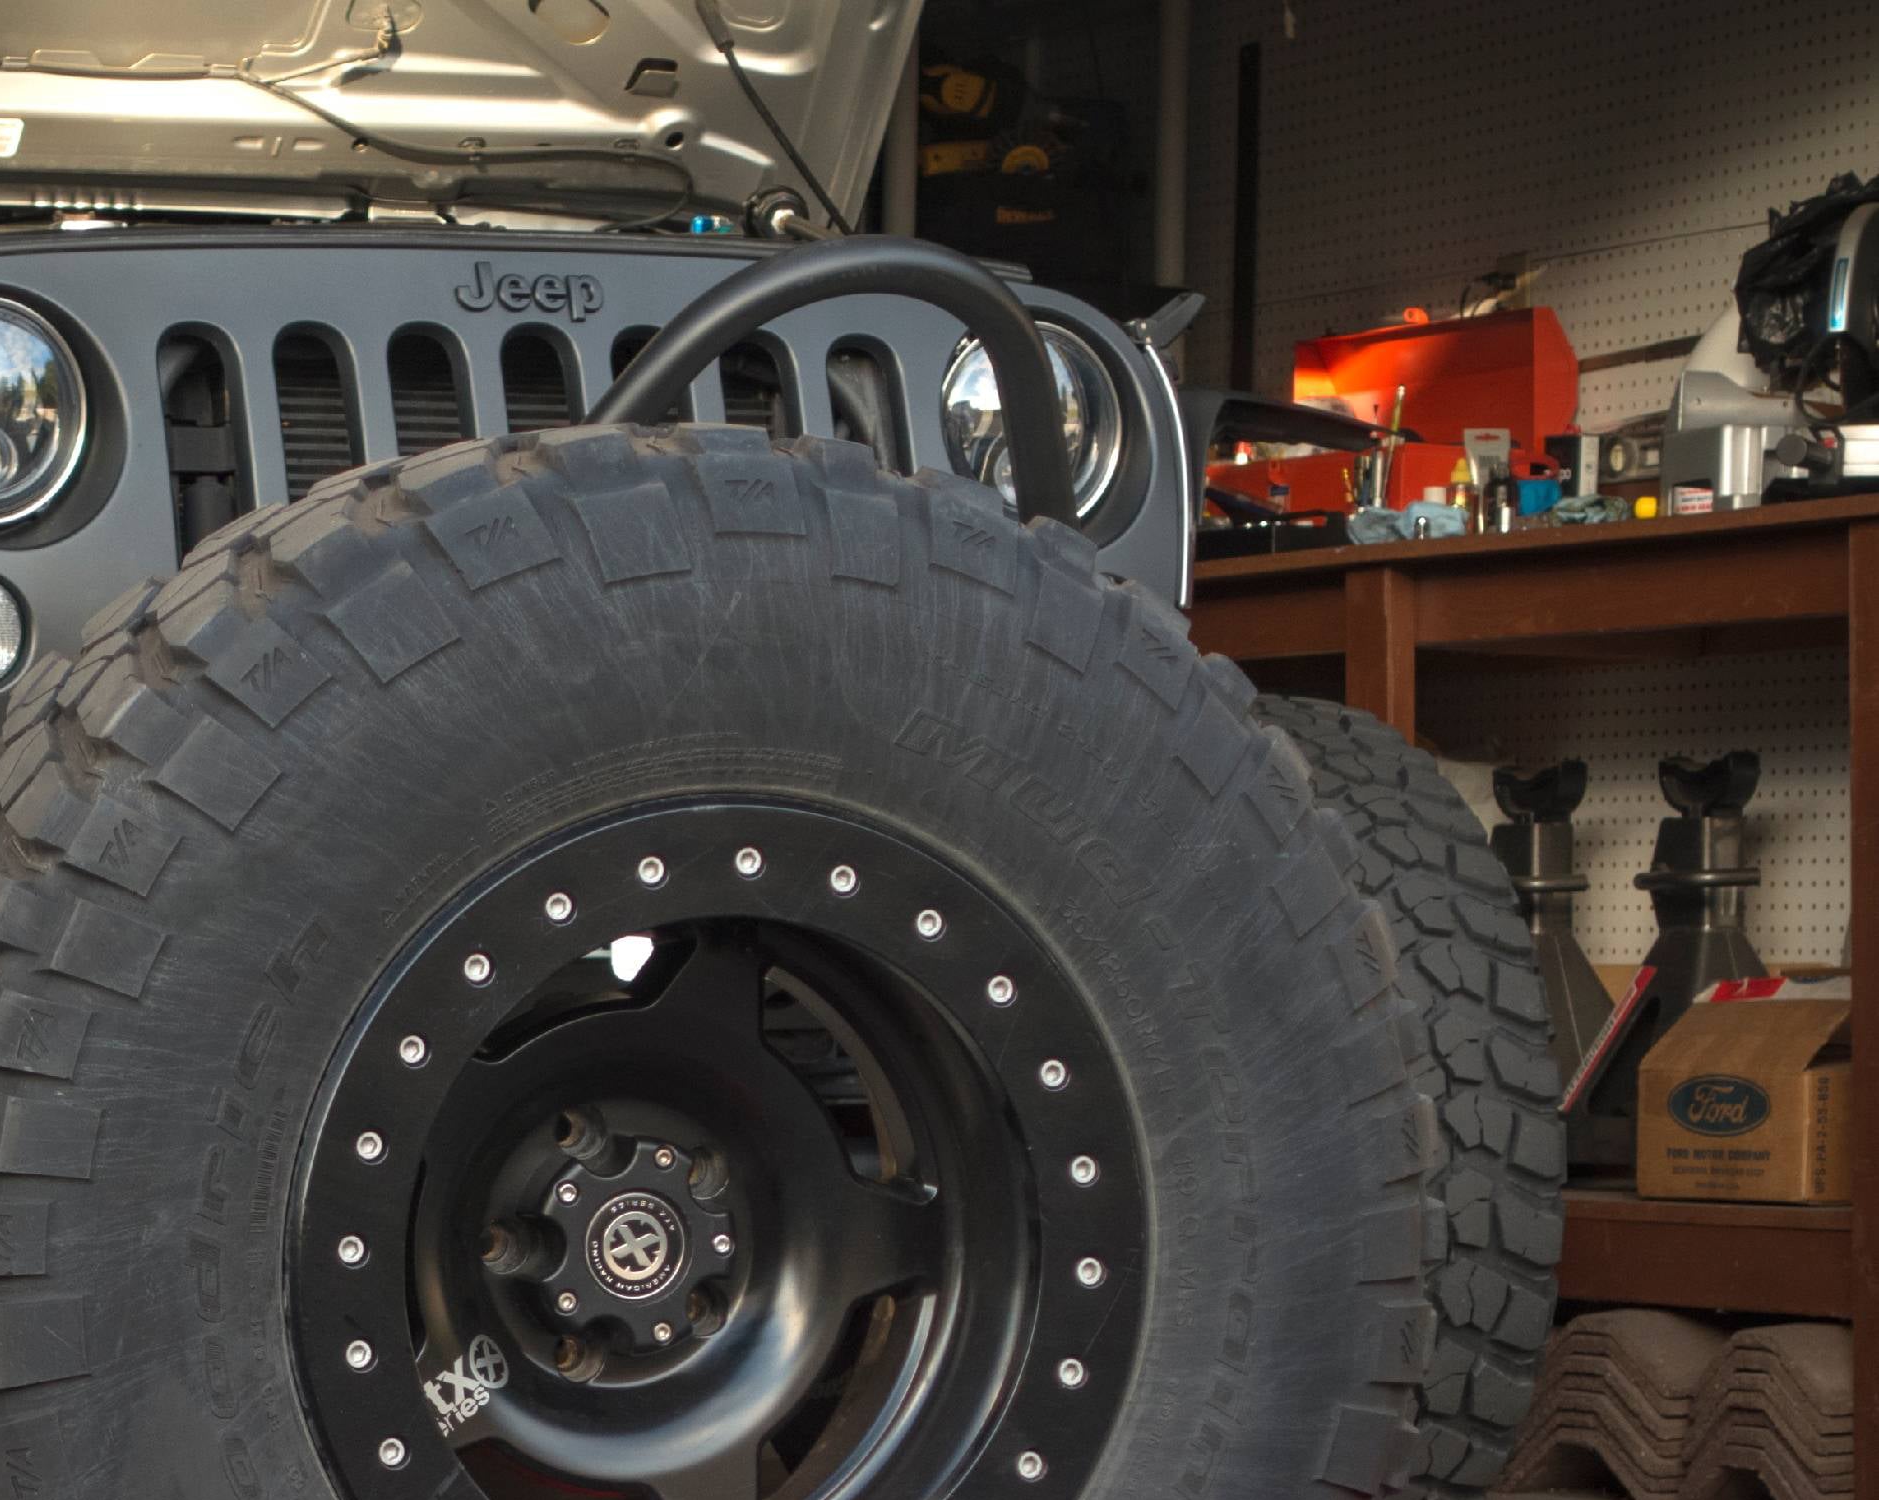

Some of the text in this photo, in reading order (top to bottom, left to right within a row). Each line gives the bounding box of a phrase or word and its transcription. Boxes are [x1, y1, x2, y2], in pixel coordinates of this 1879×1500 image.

[455, 261, 604, 322] Jeep
[727, 478, 777, 505] T/A
[464, 515, 519, 547] T/A
[241, 645, 292, 692] T/A
[98, 818, 140, 869] T/A
[16, 1007, 56, 1064] T/A
[1688, 1085, 1749, 1123] Ford
[424, 1354, 482, 1415] tx
